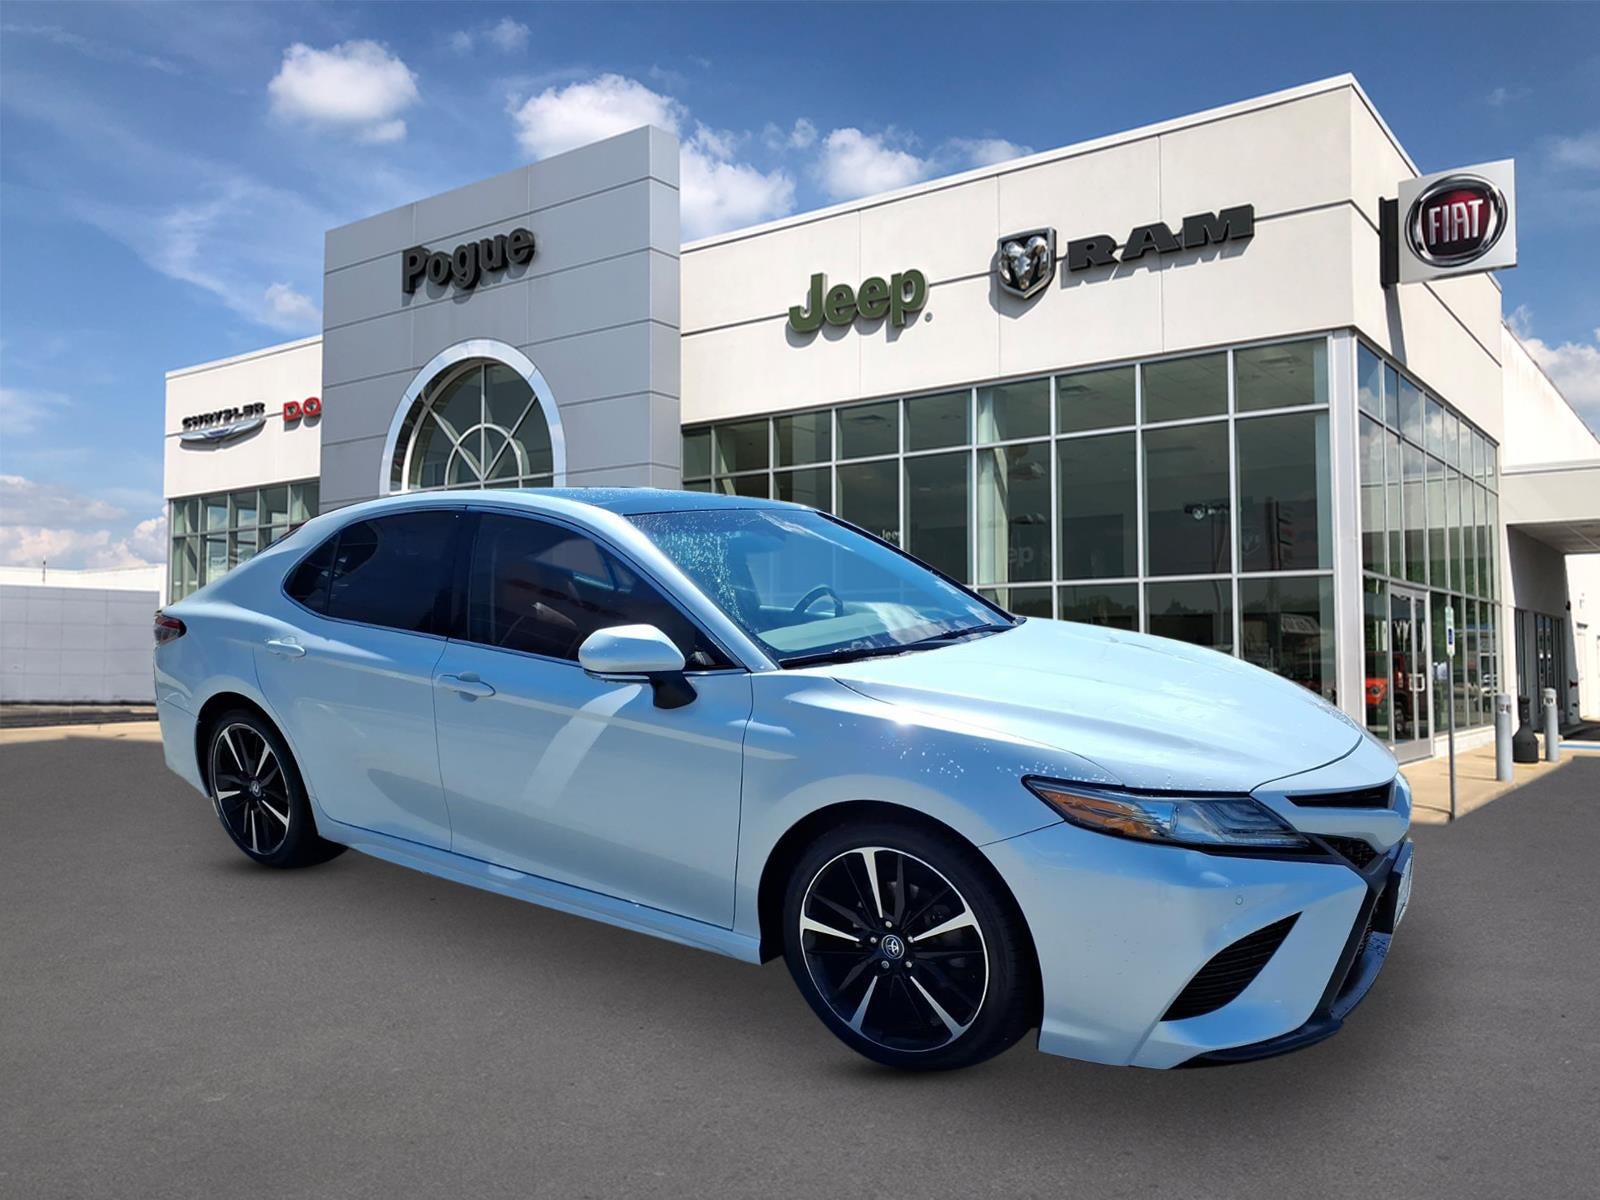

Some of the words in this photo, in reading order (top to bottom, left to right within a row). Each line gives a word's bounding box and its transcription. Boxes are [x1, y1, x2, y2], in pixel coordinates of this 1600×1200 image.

[1067, 203, 1255, 272] RAM
[1428, 198, 1484, 246] FIAT
[402, 227, 536, 294] Pogue
[788, 268, 929, 333] Jeep
[182, 402, 265, 430] CHRYSLER
